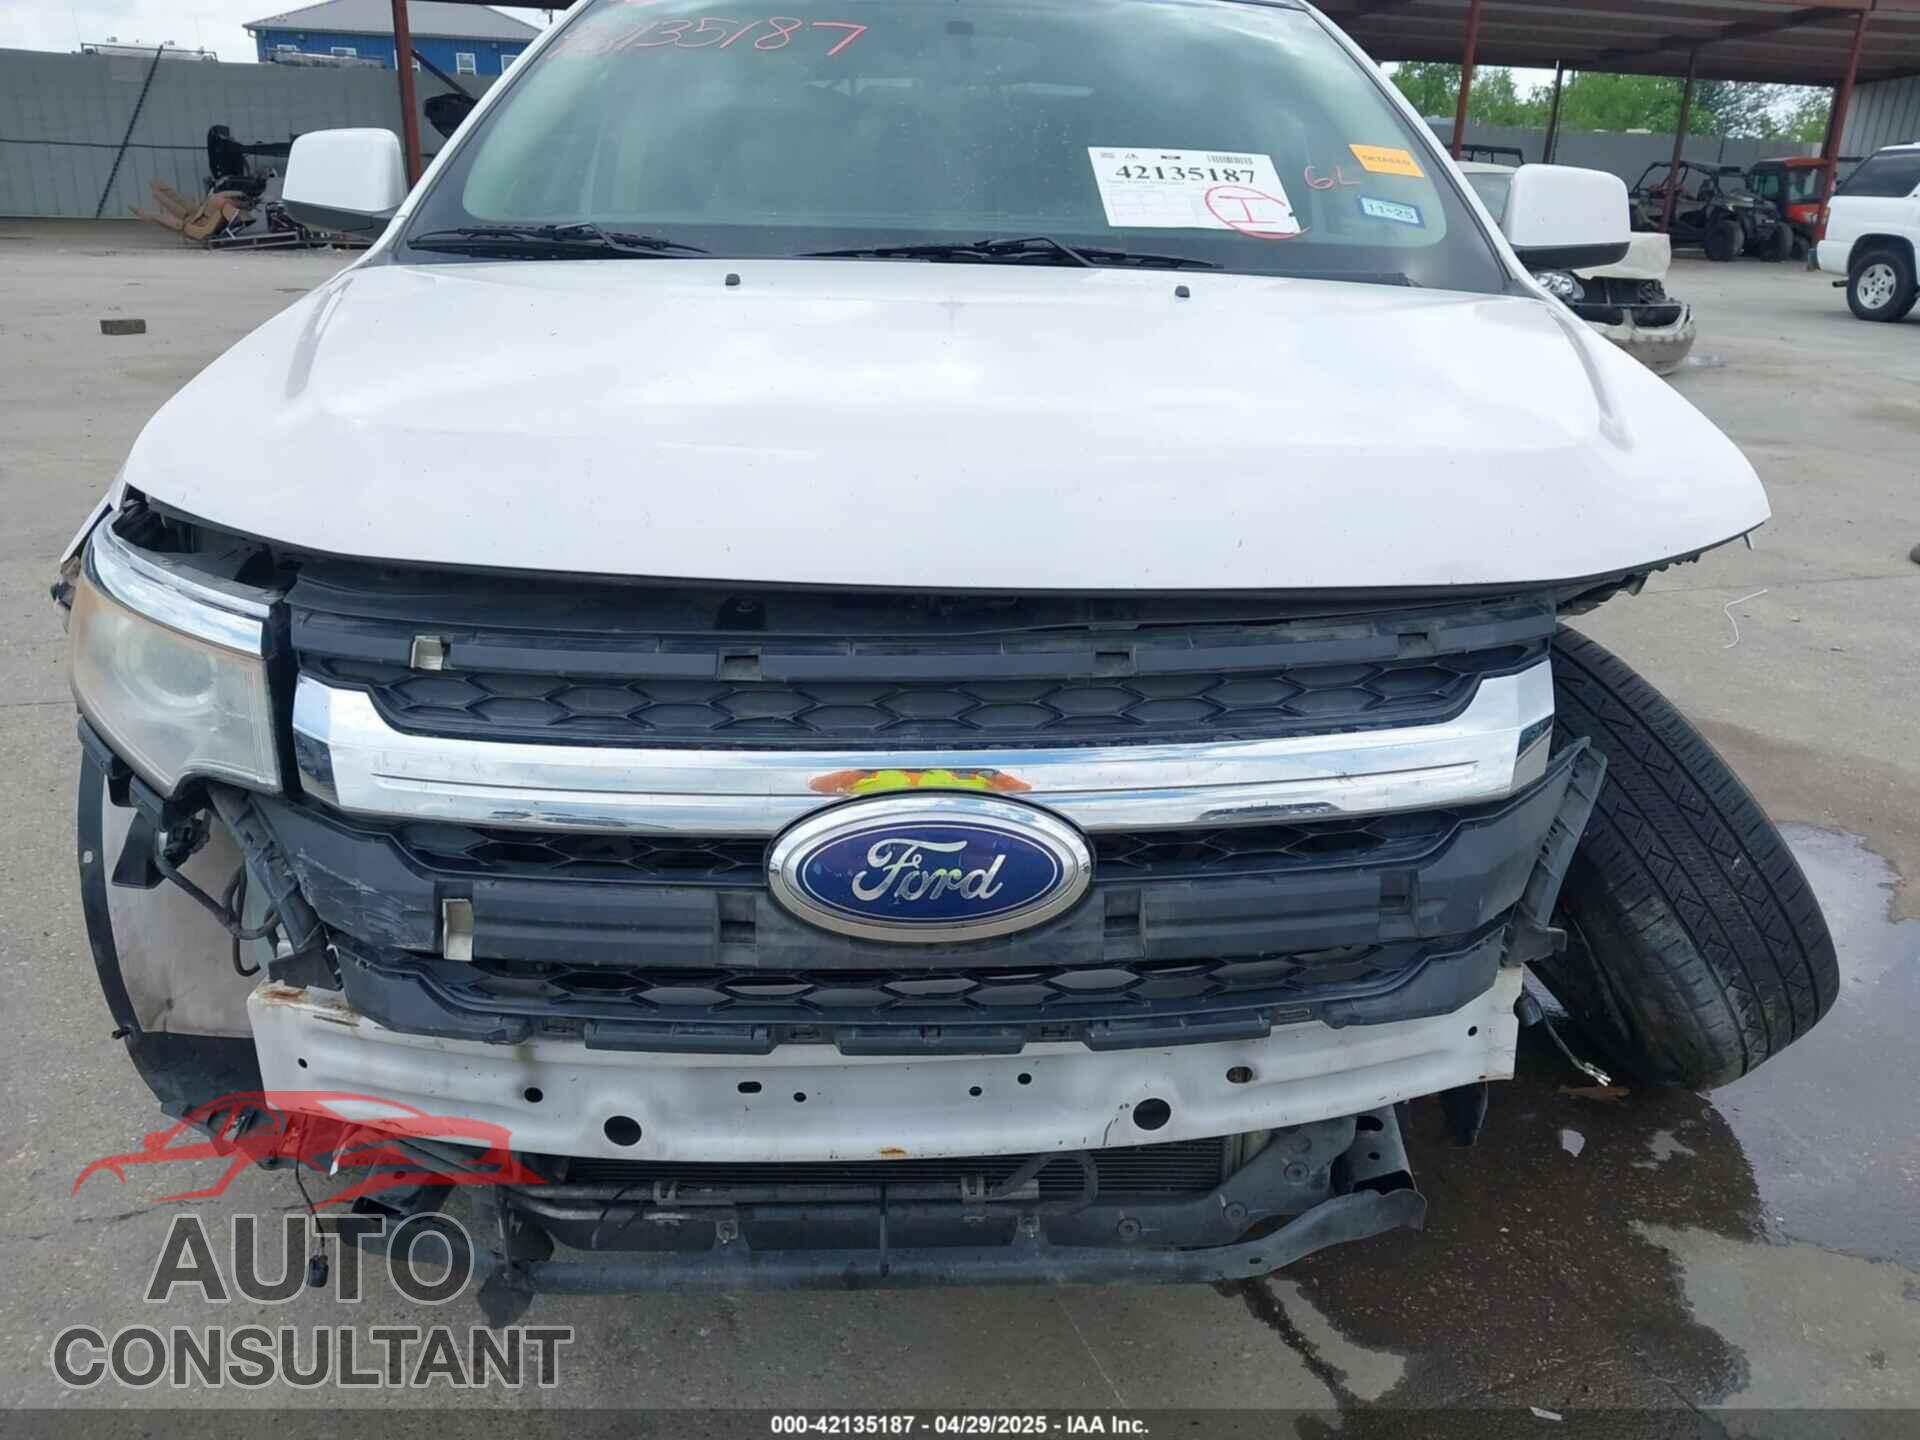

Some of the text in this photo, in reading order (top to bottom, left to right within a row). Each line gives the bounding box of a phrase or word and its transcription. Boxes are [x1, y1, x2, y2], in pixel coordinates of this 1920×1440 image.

[547, 17, 867, 56] 135187
[1115, 164, 1255, 184] 42135187
[851, 837, 1006, 902] Ford
